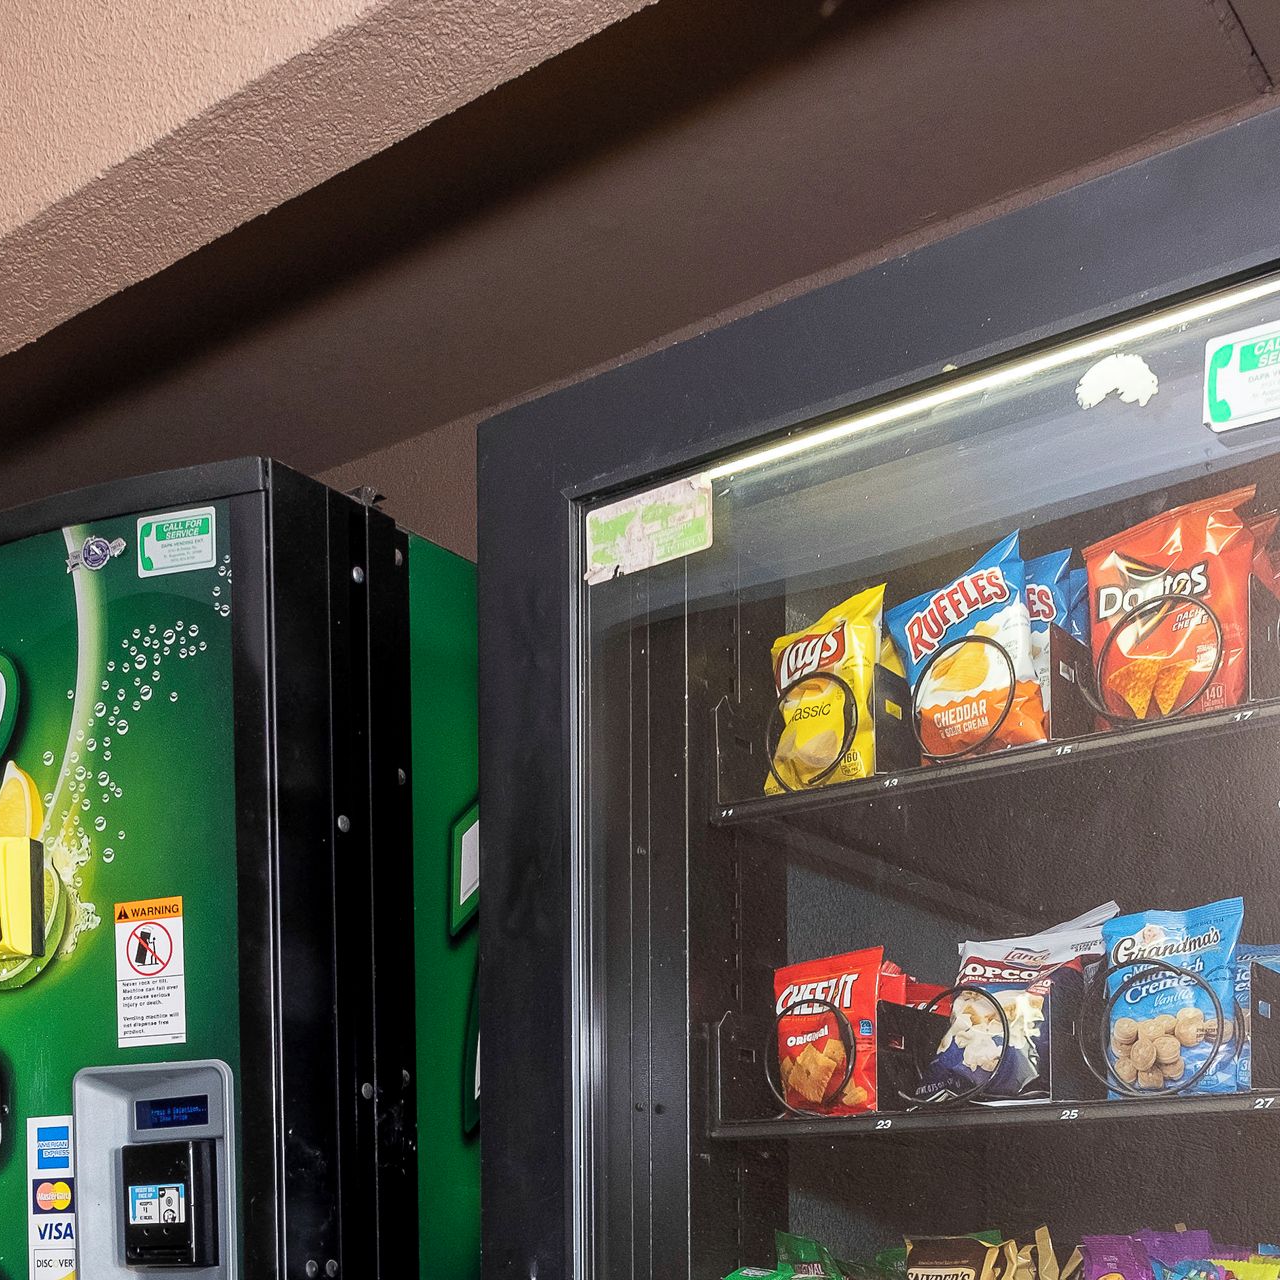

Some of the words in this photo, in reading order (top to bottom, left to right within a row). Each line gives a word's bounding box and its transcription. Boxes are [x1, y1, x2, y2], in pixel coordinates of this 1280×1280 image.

[163, 522, 184, 532] CALL
[185, 518, 202, 529] FOR
[166, 528, 200, 540] SERVICE
[906, 570, 1010, 662] RUFFLES
[1205, 686, 1223, 700] 140
[933, 699, 987, 729] CHEDDAR
[1234, 711, 1254, 721] 17
[963, 716, 990, 734] CREAM
[1056, 745, 1072, 755] 15
[130, 904, 180, 919] WARNING
[1112, 927, 1221, 966] Grandma's
[1254, 1097, 1275, 1109] 27
[1060, 1109, 1079, 1119] 25
[876, 1119, 892, 1129] 23
[37, 1222, 74, 1240] VISA
